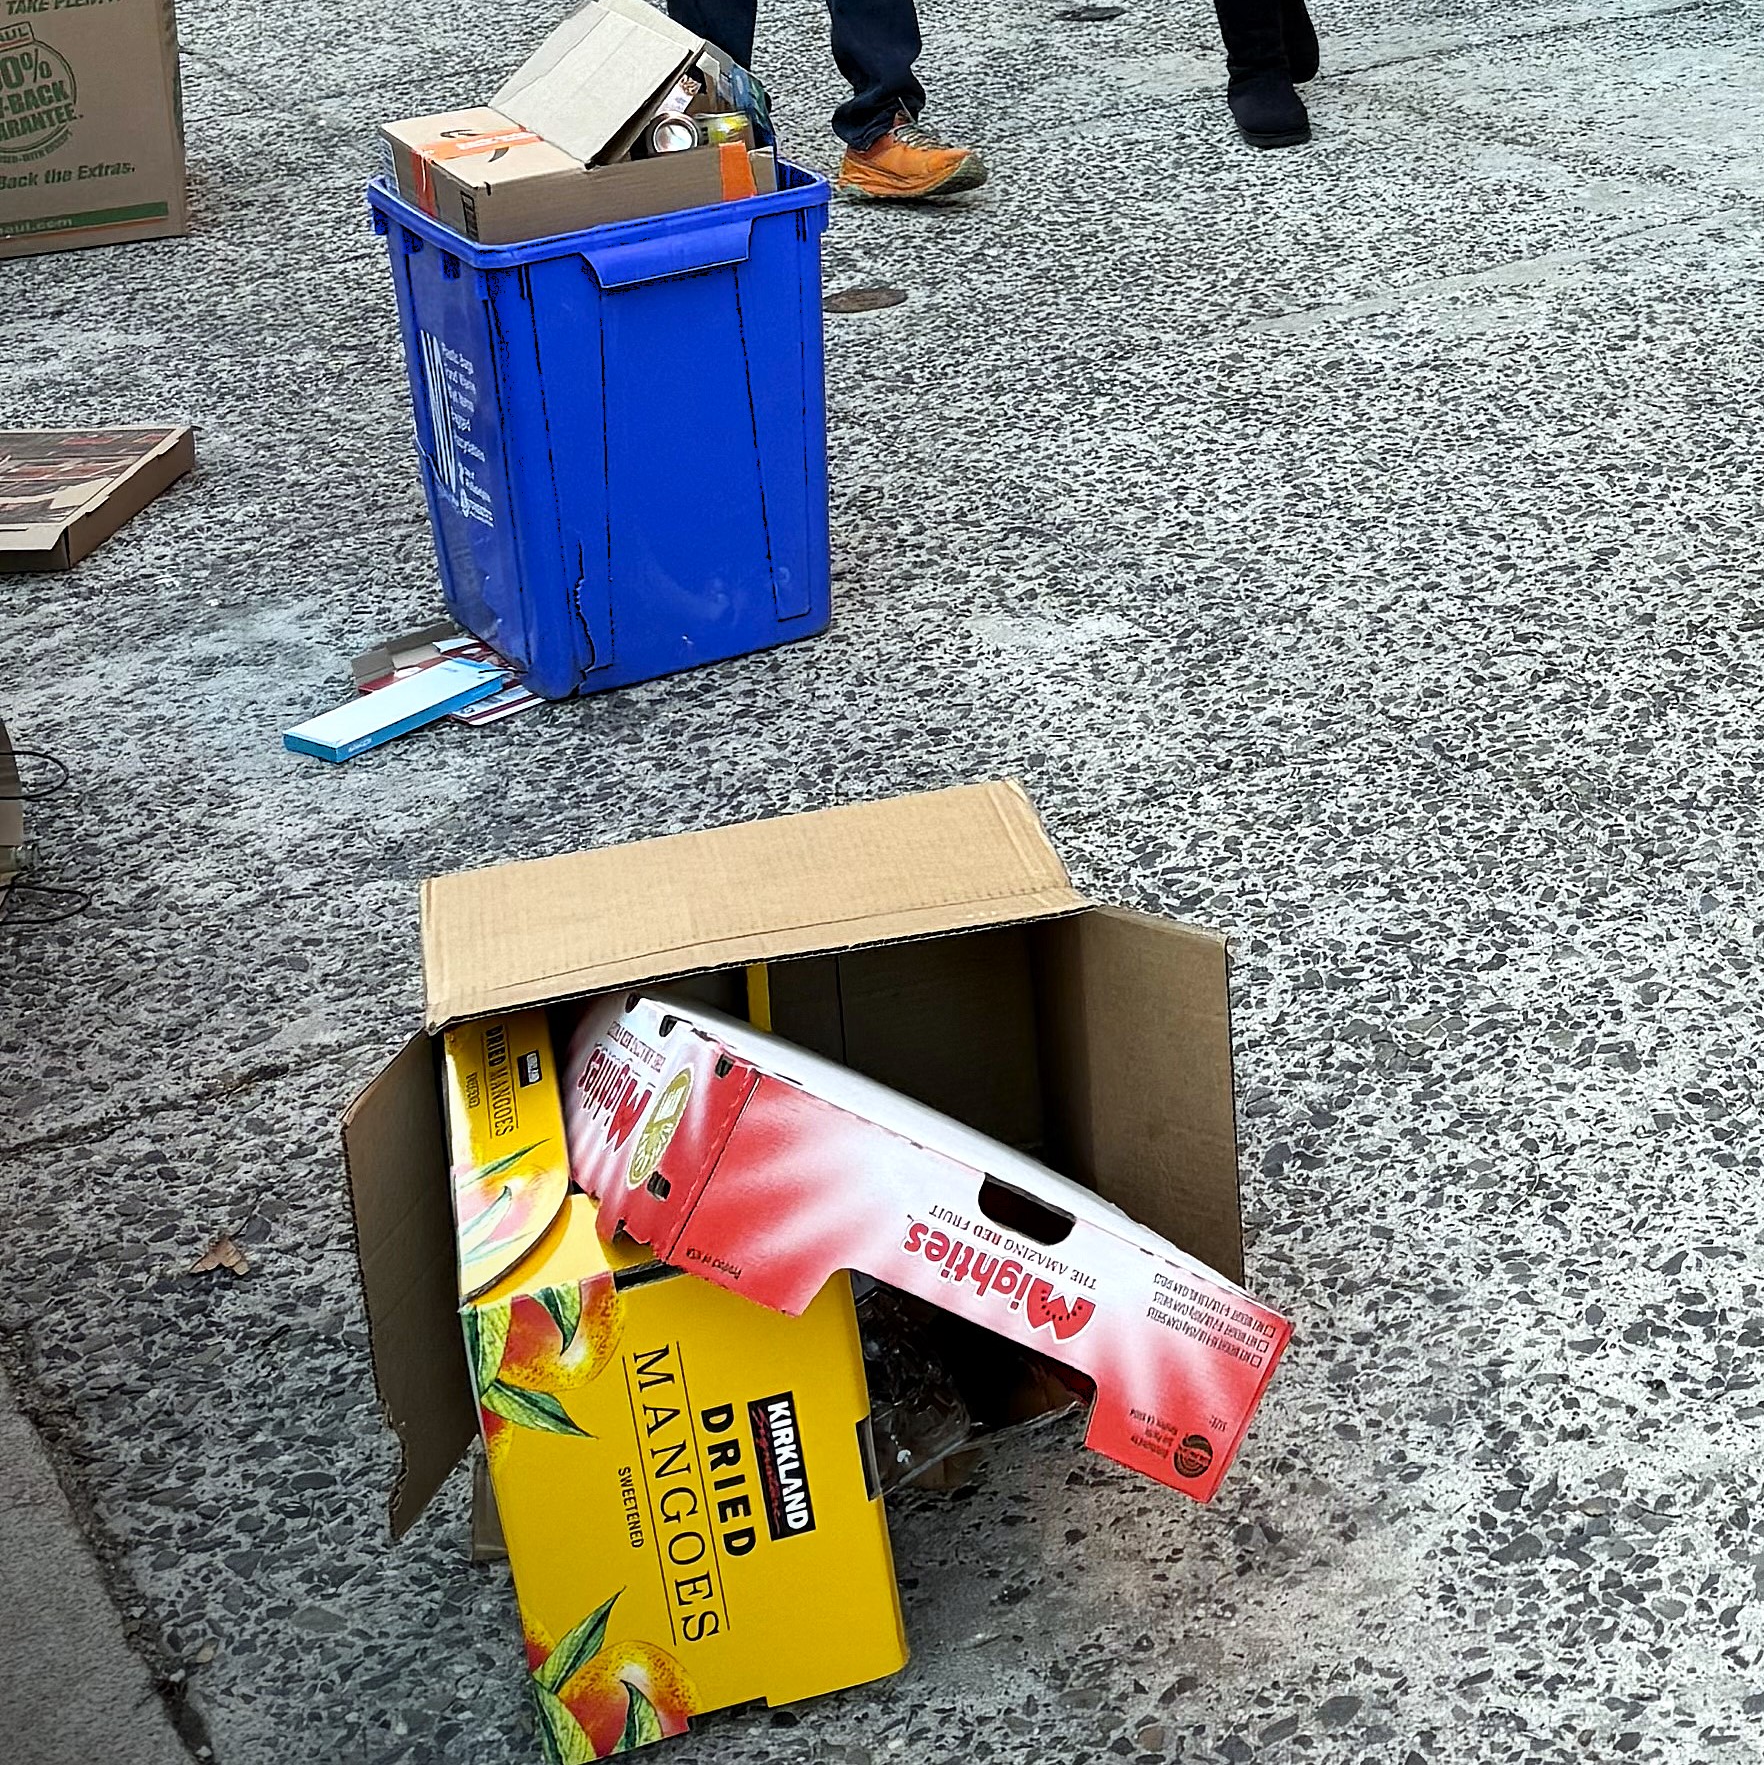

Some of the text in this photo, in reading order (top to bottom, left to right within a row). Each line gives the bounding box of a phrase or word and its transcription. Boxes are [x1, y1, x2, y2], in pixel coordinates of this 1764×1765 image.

[44, 168, 72, 184] the
[78, 162, 135, 181] Extras.
[485, 1024, 514, 1137] DRIED MANGOES
[904, 1222, 1096, 1340] Mighties
[929, 1205, 1097, 1291] THE AMAZING RED FRUIT
[618, 1467, 644, 1549] SWEETENED
[633, 1344, 720, 1642] MANGOES
[701, 1403, 756, 1557] DRIED
[767, 1400, 809, 1530] KIRKLAND
